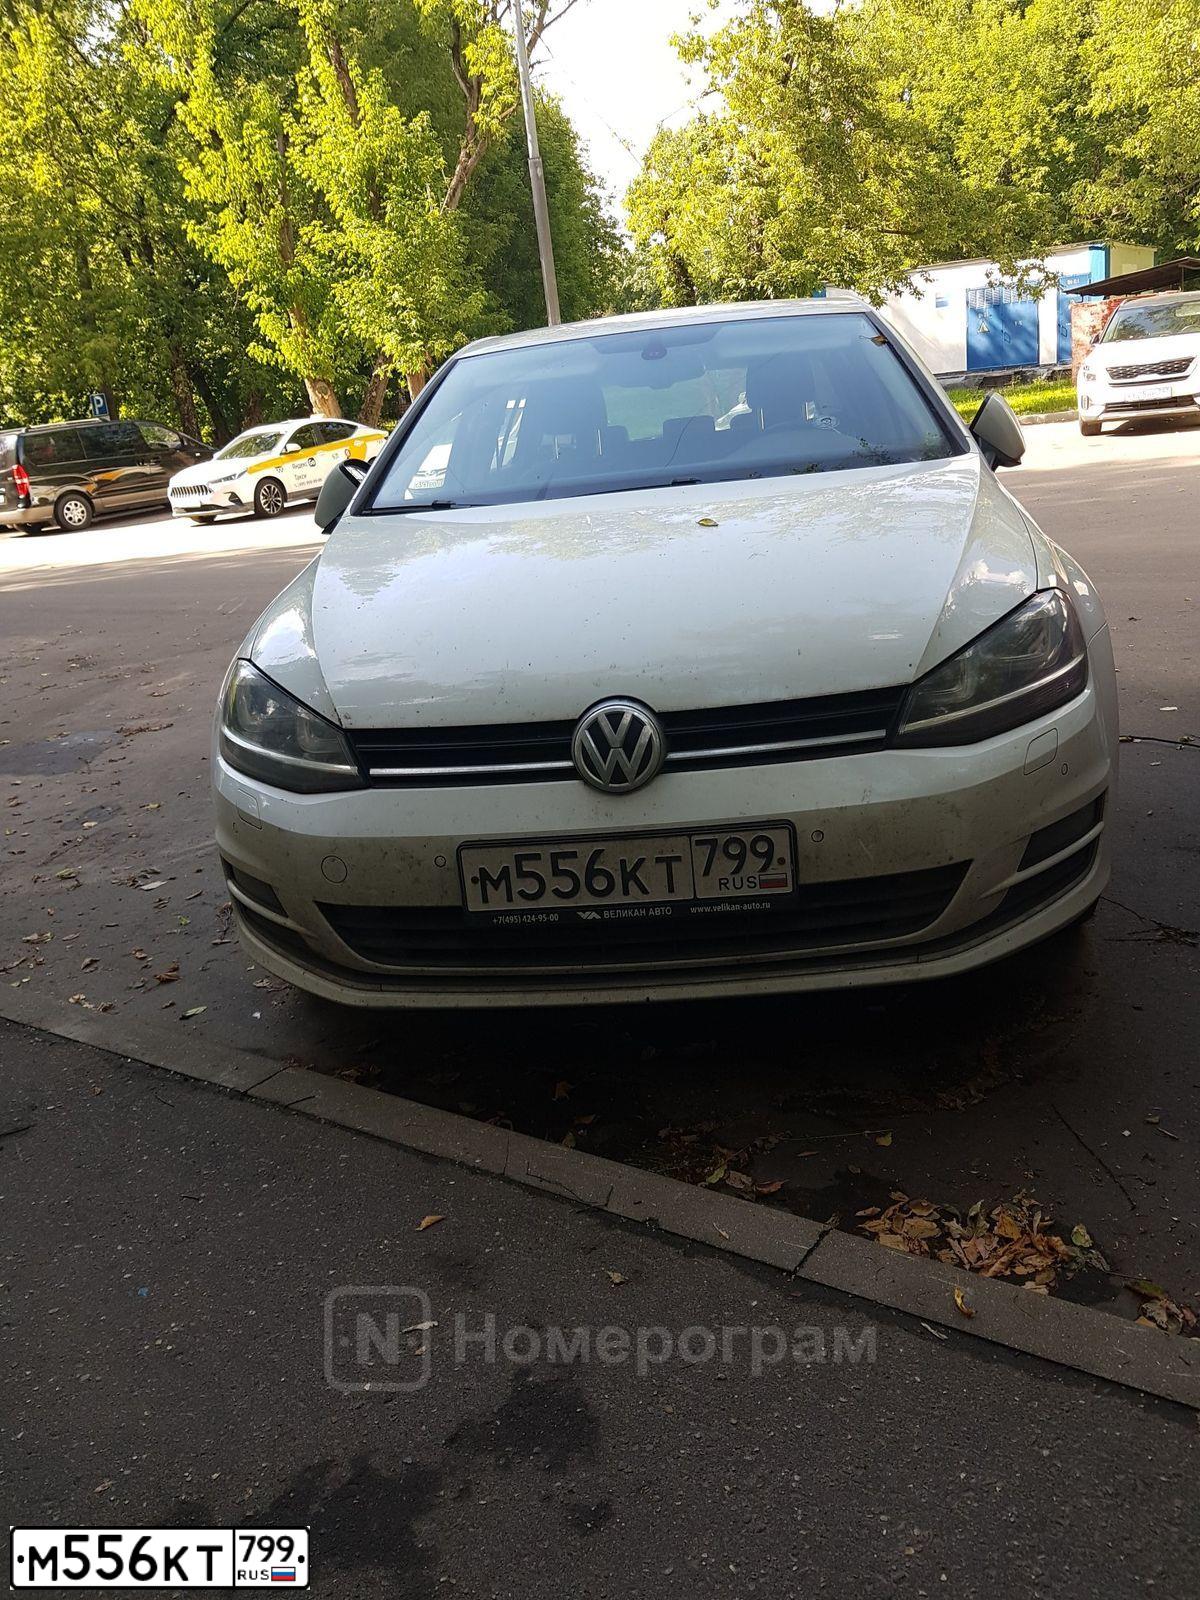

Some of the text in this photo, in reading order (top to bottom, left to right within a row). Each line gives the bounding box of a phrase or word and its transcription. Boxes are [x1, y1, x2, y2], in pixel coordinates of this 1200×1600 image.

[94, 396, 104, 415] P
[695, 834, 775, 877] 799
[718, 875, 758, 891] RUS
[603, 907, 672, 919] ВЕЛИКАН АВТО
[690, 902, 771, 914] www.velikan-auto.ru
